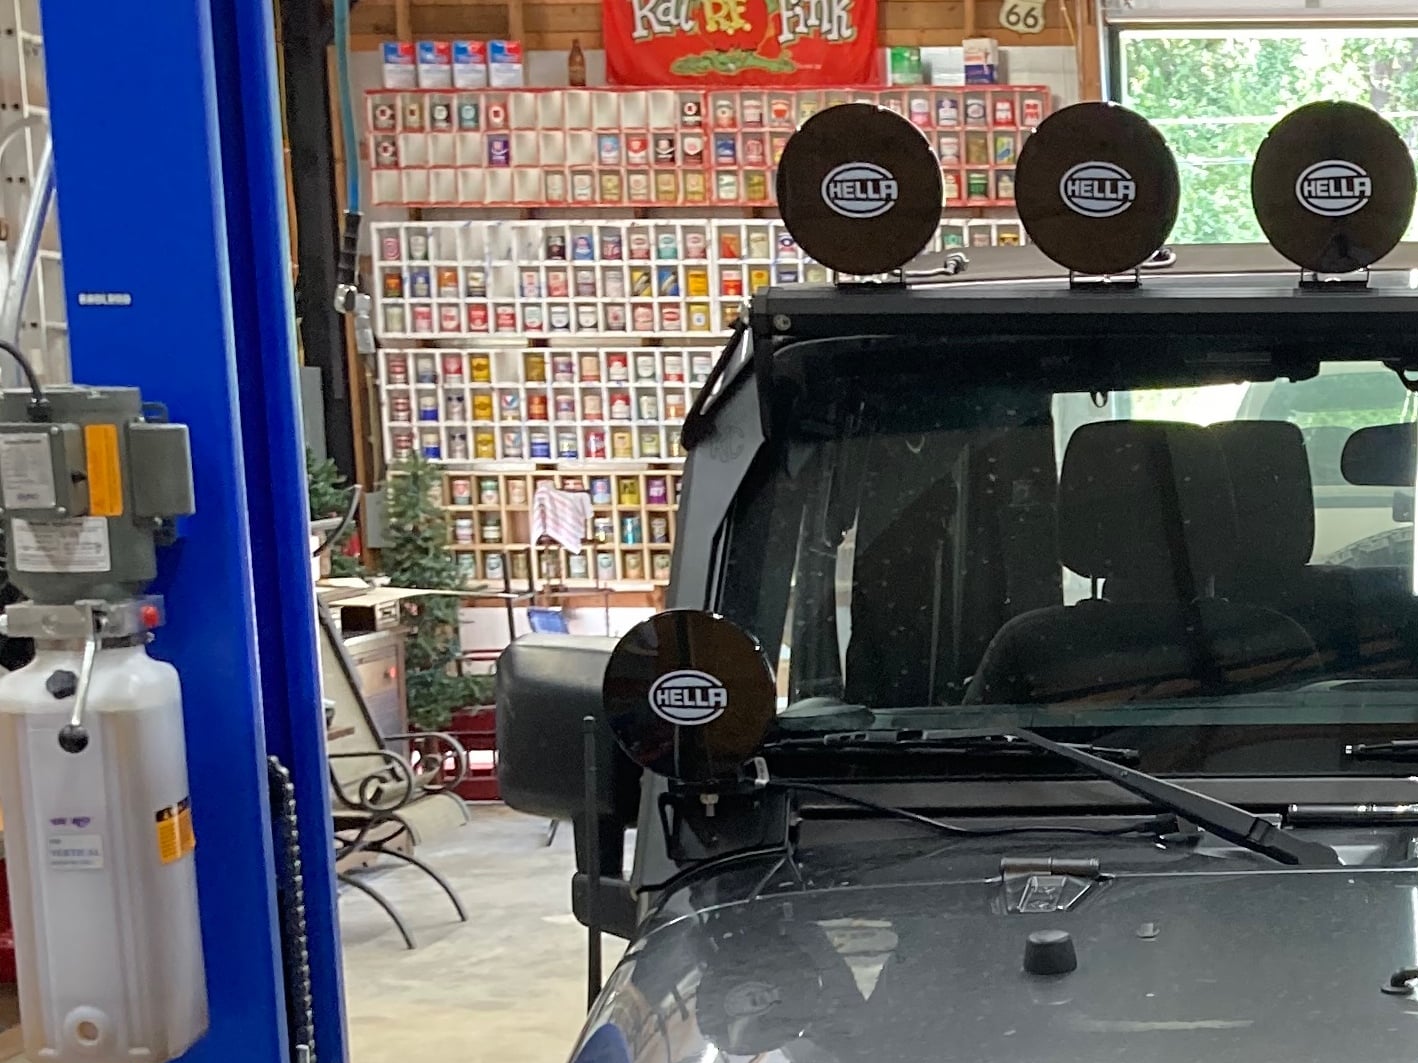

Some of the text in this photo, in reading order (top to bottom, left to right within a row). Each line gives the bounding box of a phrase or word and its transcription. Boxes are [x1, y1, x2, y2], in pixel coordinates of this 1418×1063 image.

[1006, 4, 1039, 29] 66
[829, 180, 898, 200] HELLA
[1067, 180, 1136, 200] HELLA
[1304, 177, 1372, 197] HELLA
[656, 687, 728, 707] HELLA
